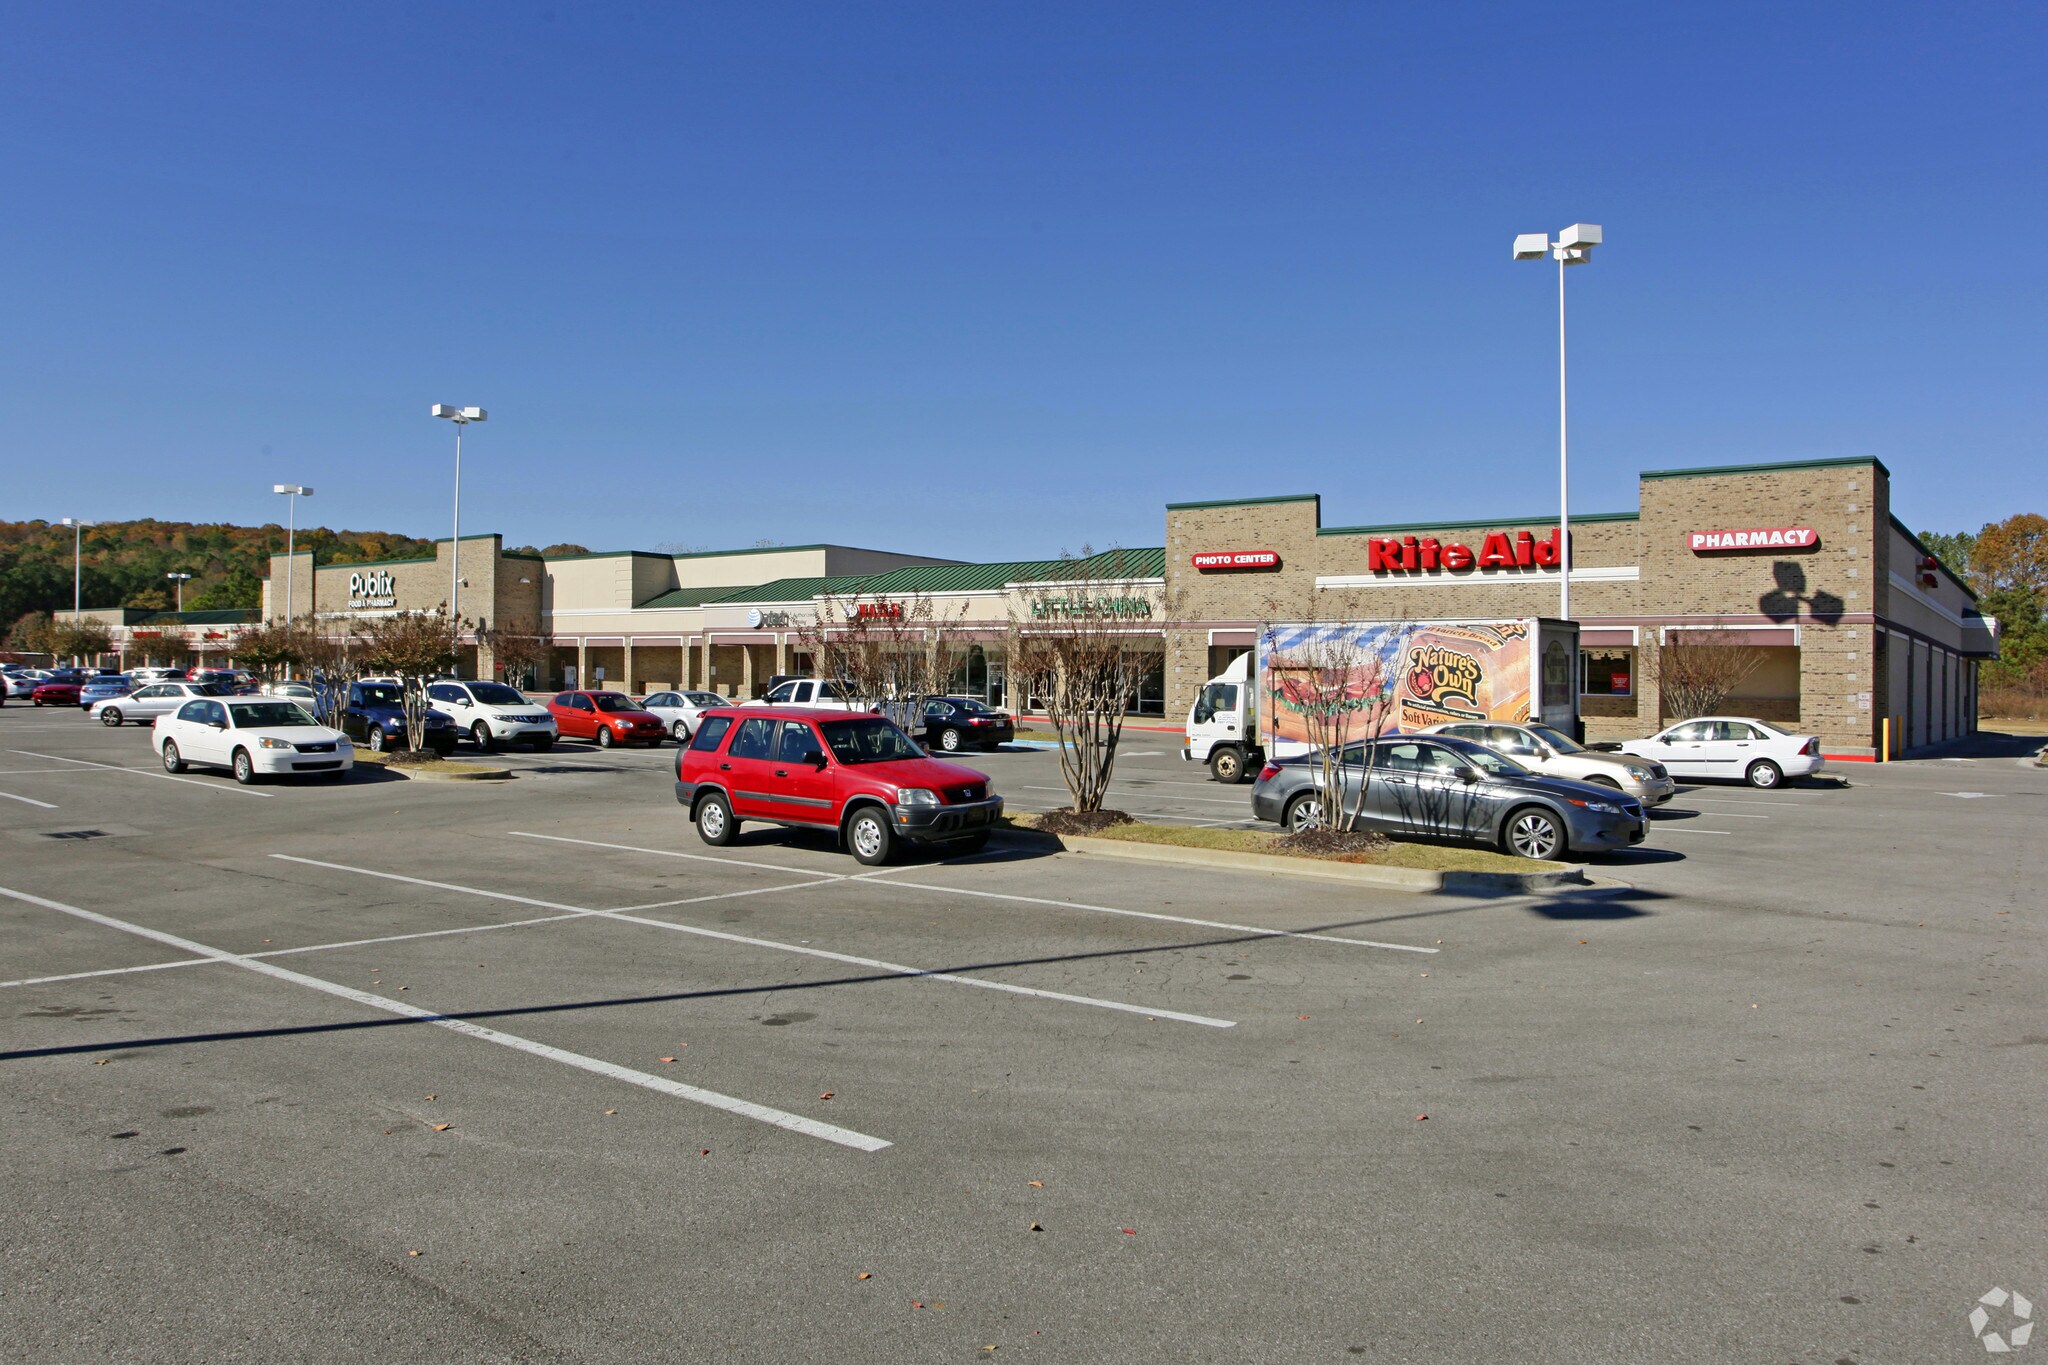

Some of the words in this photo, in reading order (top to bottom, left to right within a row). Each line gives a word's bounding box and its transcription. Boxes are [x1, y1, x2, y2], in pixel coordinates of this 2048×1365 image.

[1692, 530, 1811, 547] PHARMACY
[1368, 536, 1474, 571] Rite
[1476, 527, 1562, 567] Aid
[1195, 556, 1231, 565] PHOTO
[1234, 554, 1274, 563] CENTER
[350, 570, 394, 597] Publix
[348, 600, 362, 608] FOOD
[367, 598, 395, 607] PHARMACY
[1095, 596, 1149, 614] CHINA
[1410, 645, 1479, 680] Nature's
[1432, 664, 1476, 700] Own
[1402, 709, 1421, 725] Soft
